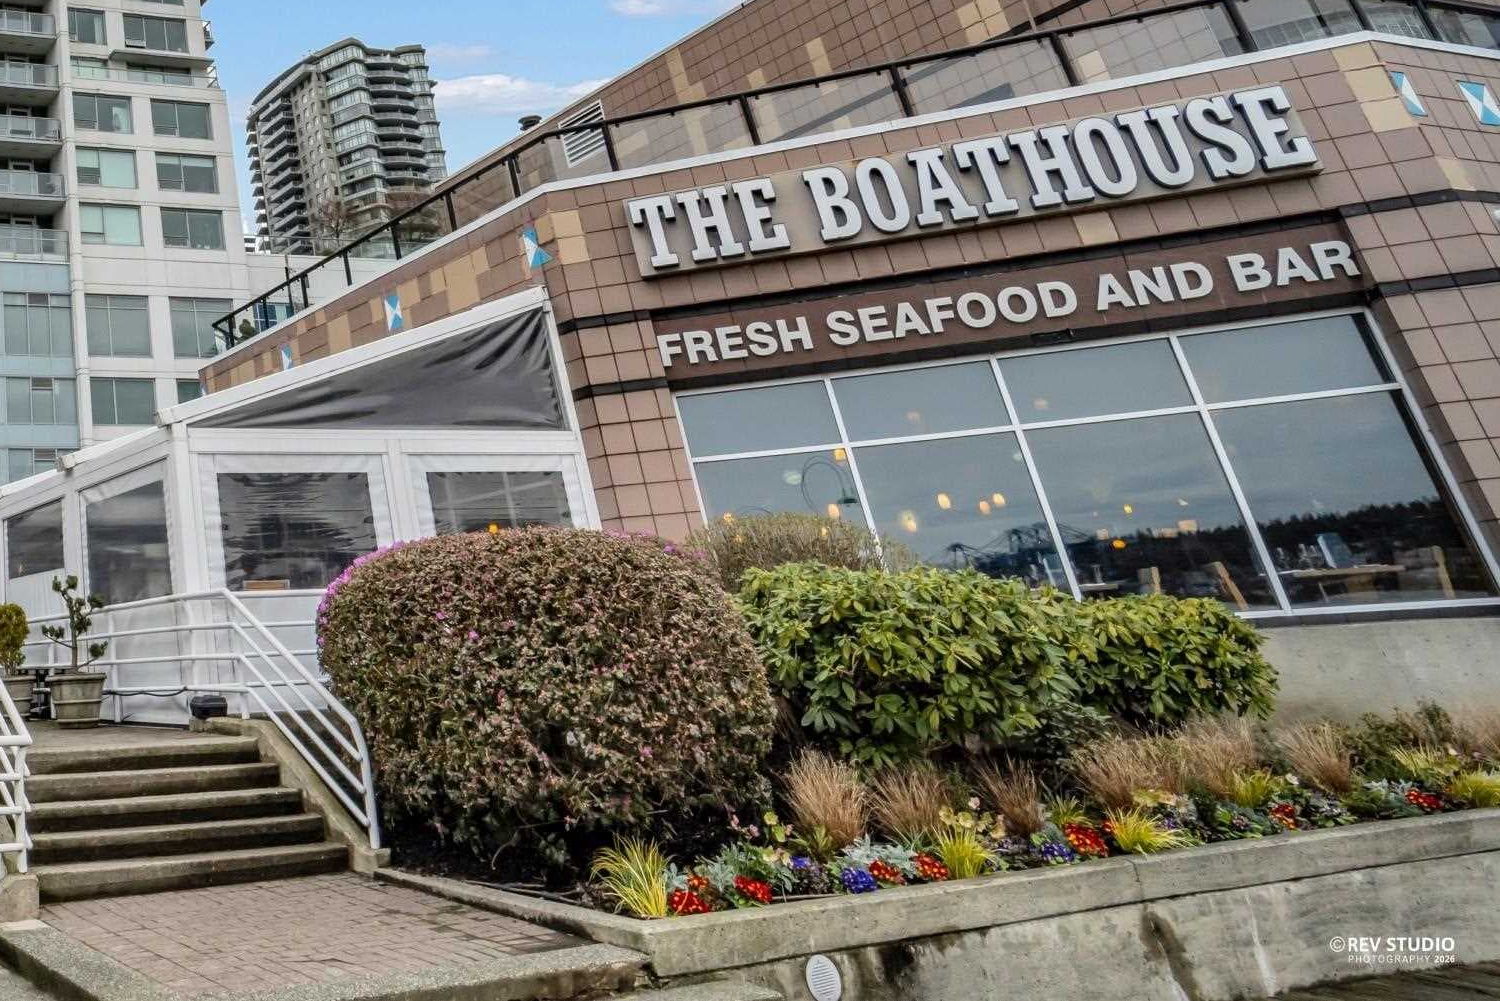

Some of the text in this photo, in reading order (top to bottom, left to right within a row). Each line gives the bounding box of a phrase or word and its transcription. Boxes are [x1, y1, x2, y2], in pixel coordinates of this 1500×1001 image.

[628, 86, 1318, 268] THE BOATHOUSE
[657, 240, 1361, 367] FRESH SEAFOOD AND BAR
